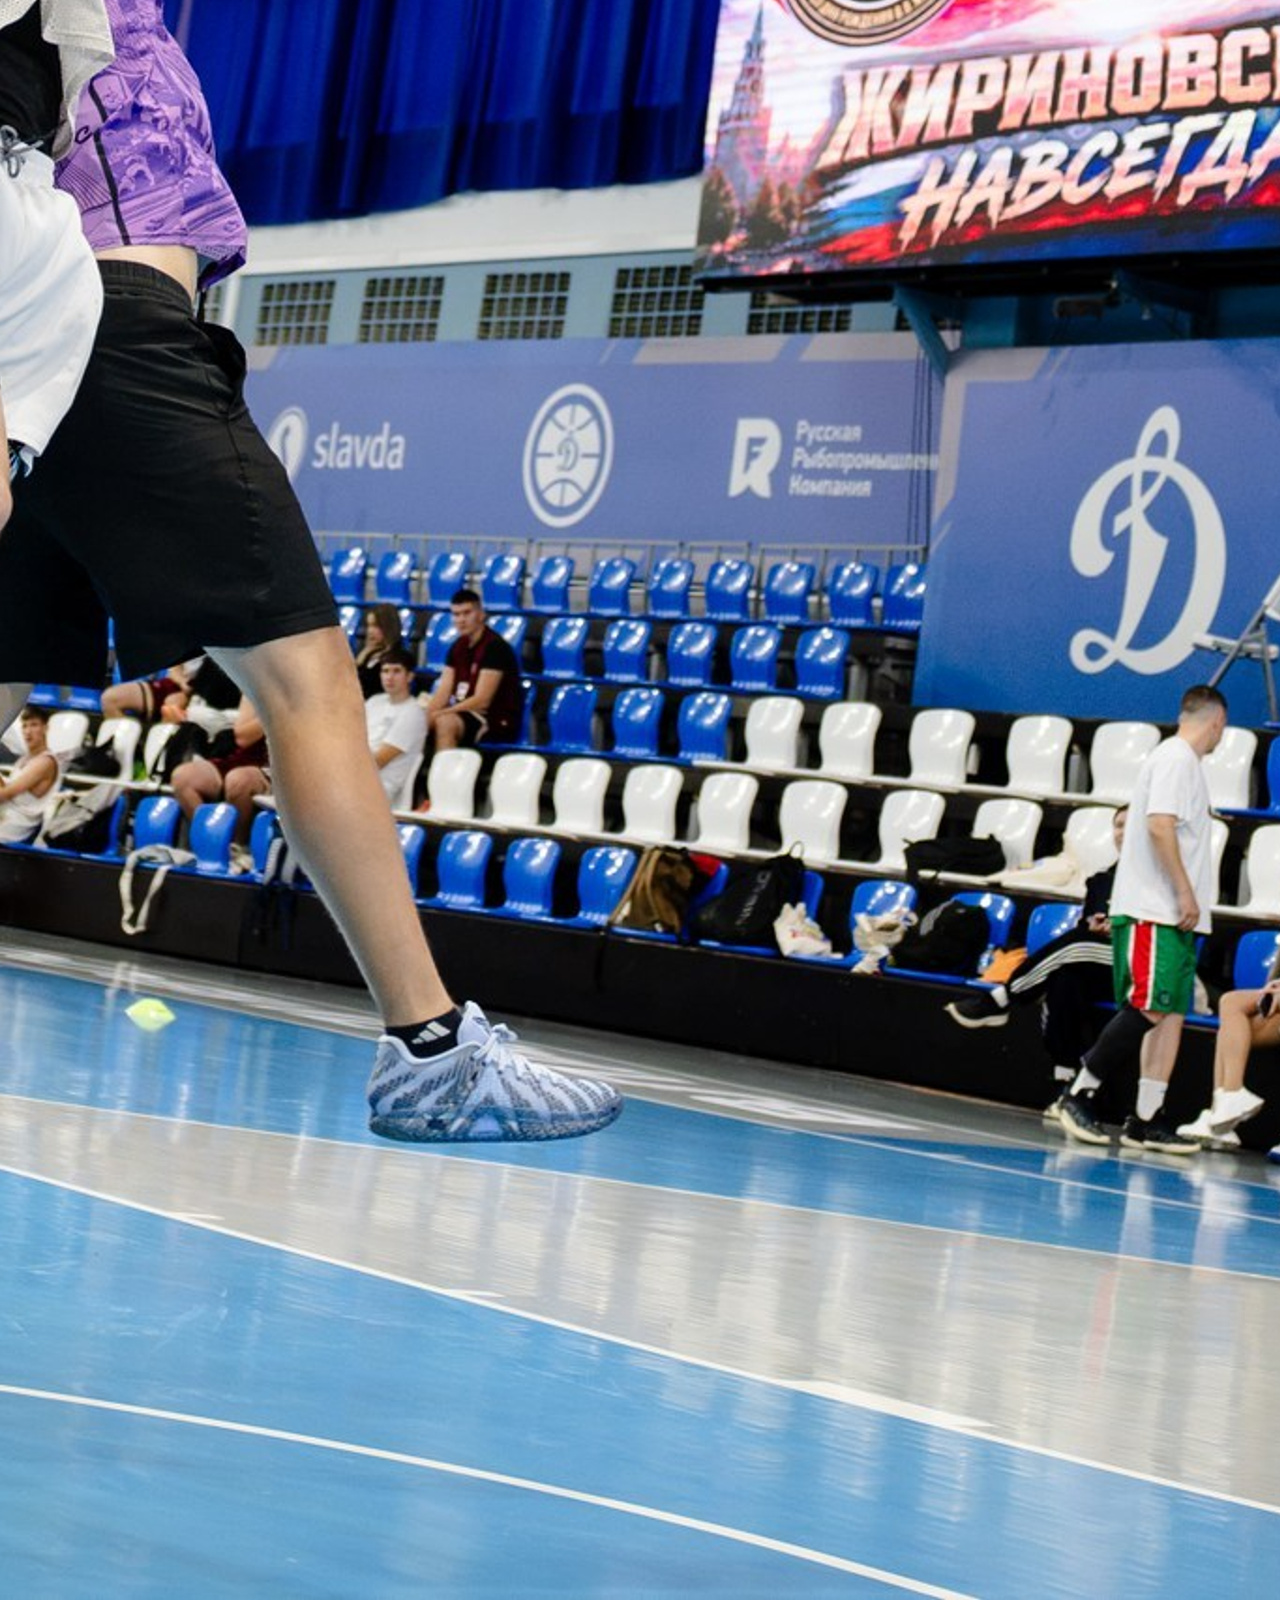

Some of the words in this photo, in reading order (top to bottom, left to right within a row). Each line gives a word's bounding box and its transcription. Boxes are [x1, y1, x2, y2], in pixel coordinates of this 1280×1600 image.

[311, 421, 406, 471] slavda
[794, 419, 862, 446] Русская
[787, 473, 872, 498] Компания
